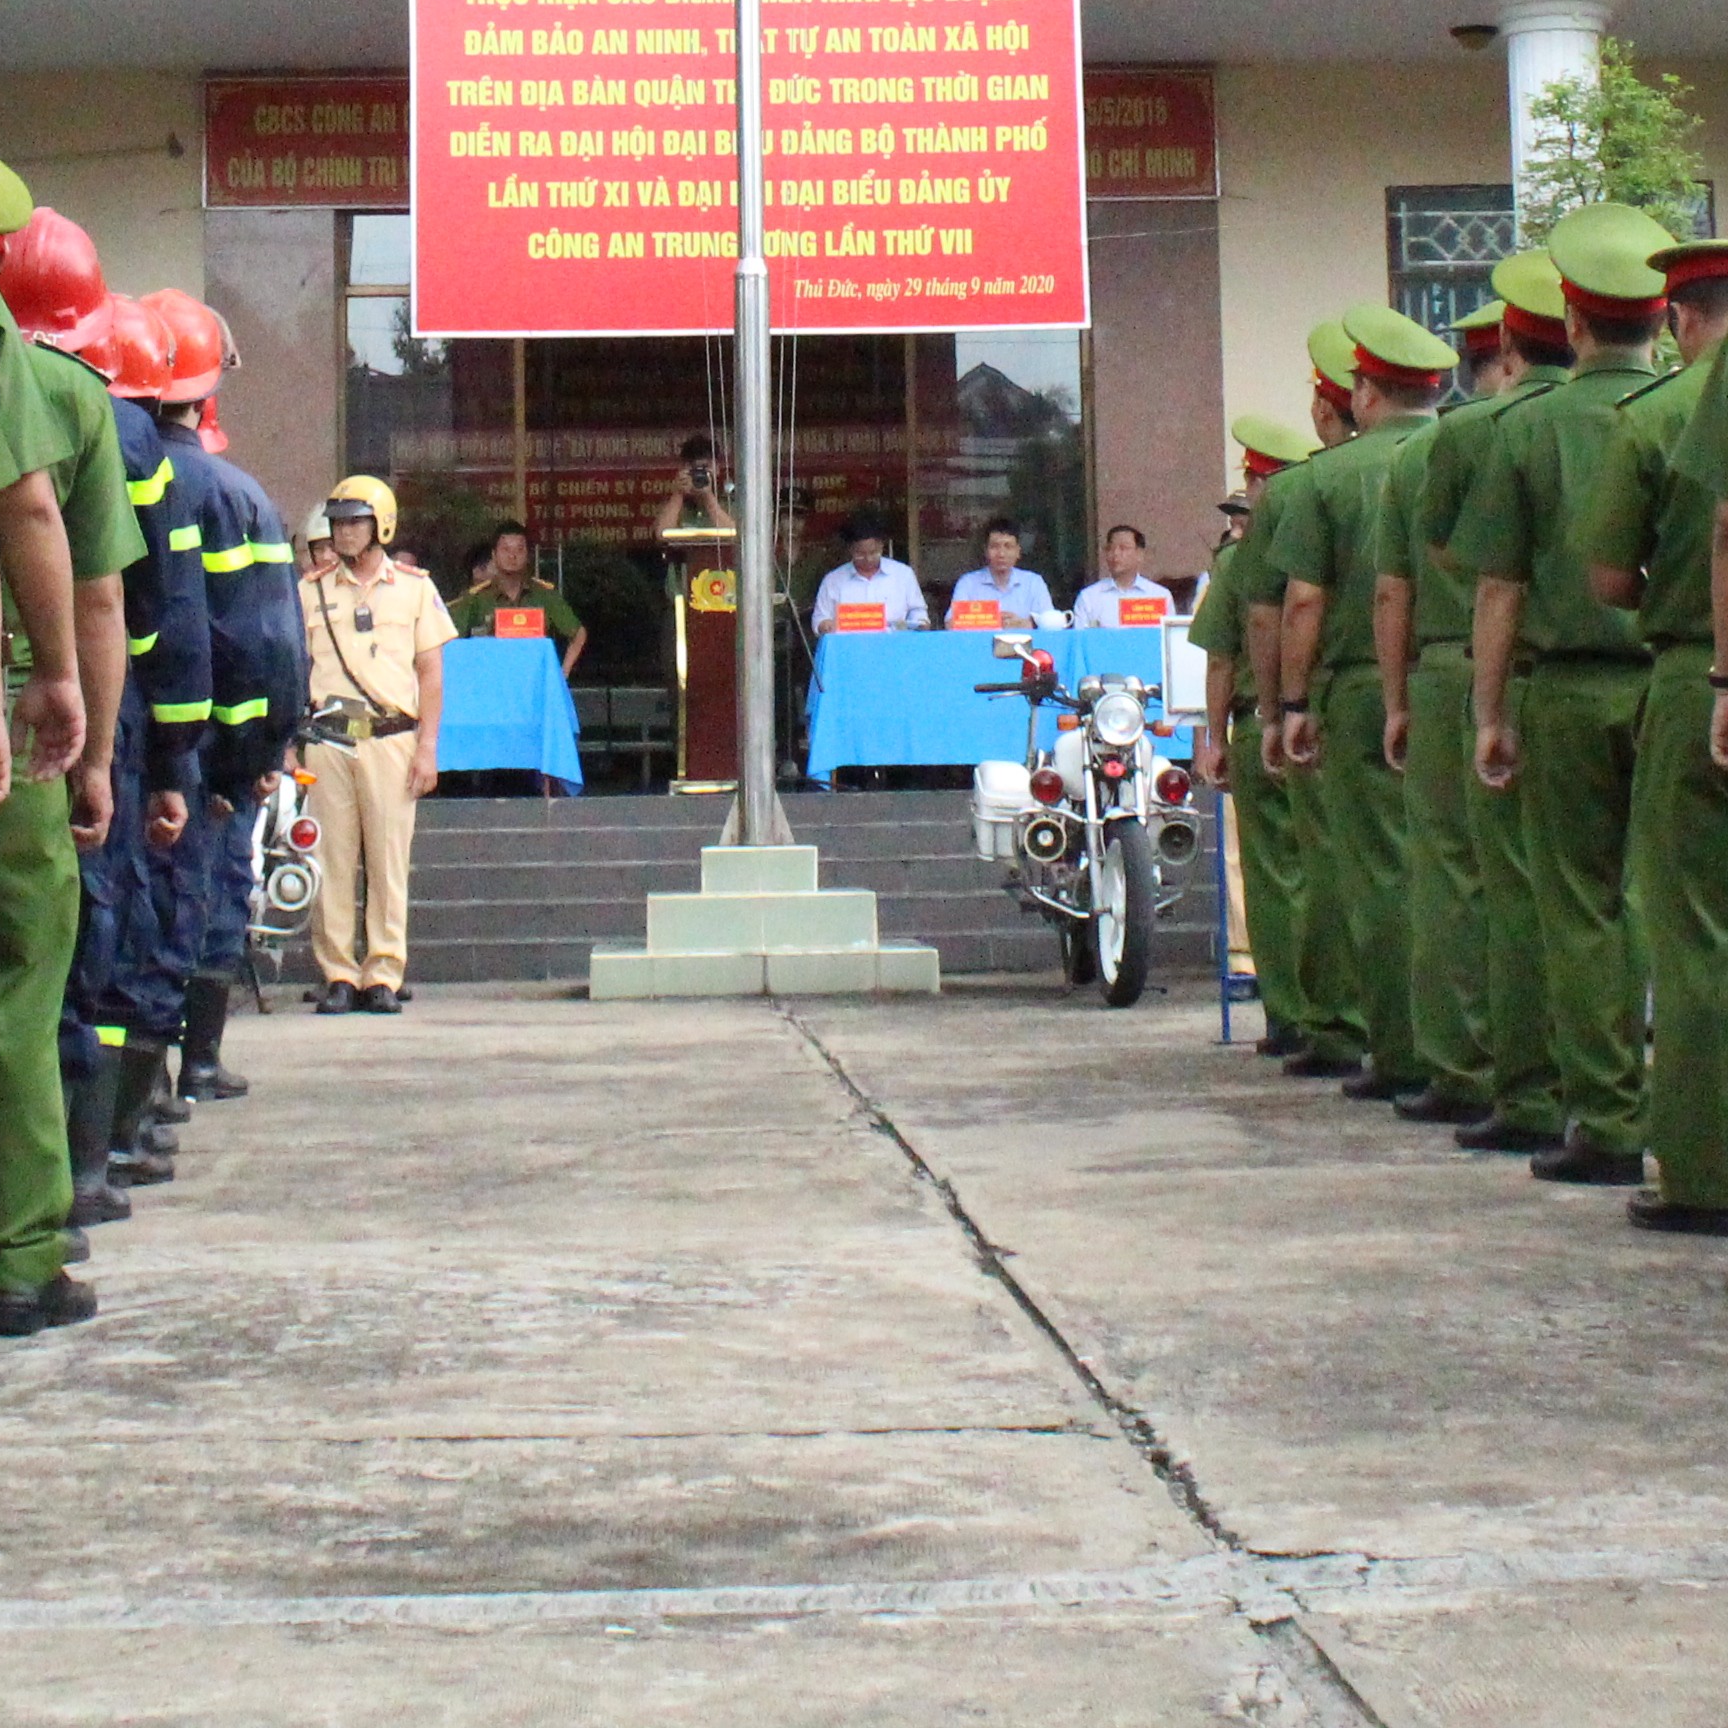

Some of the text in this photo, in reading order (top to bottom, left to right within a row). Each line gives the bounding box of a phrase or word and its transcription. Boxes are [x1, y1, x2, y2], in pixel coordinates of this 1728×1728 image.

[464, 21, 524, 56] ĐẢM
[532, 21, 584, 56] BẢO
[592, 29, 628, 55] AN
[636, 28, 708, 57] NINH,
[786, 25, 819, 59] TỰ
[825, 27, 861, 53] AN
[869, 21, 936, 53] TOÀN
[944, 20, 978, 51] XÃ
[986, 19, 1028, 55] HỘI
[446, 75, 513, 106] TRÊN
[521, 80, 564, 112] ĐỊA
[573, 74, 626, 106] BÀN
[634, 74, 705, 110] QUẬN
[769, 73, 821, 104] ĐỨC
[829, 77, 914, 103] TRONG
[922, 70, 978, 102] THỜI
[987, 75, 1049, 101] GIAN
[450, 122, 511, 158] DIỄN
[519, 130, 553, 157] RA
[560, 130, 604, 162] ĐẠI
[612, 124, 655, 161] HỘI
[662, 130, 706, 161] ĐẠI
[781, 120, 853, 155] ĐẢNG
[861, 122, 895, 159] BỘ
[903, 122, 987, 153] THÀNH
[995, 115, 1048, 152] PHỐ
[488, 173, 538, 208] LẦN
[546, 176, 598, 208] THỨ
[604, 181, 629, 207] XI
[637, 175, 670, 206] VÀ
[678, 180, 721, 212] ĐẠI
[781, 179, 823, 211] ĐẠI
[833, 169, 891, 205] BIỂU
[899, 169, 970, 204] ĐẢNG
[978, 168, 1010, 203] ỦY
[528, 221, 972, 258] CÔNG AN TRUNG ƠNG LẦN THỨ VII
[794, 275, 1055, 301] Thủ Đức, ngày 29 tháng 9 năm 2020
